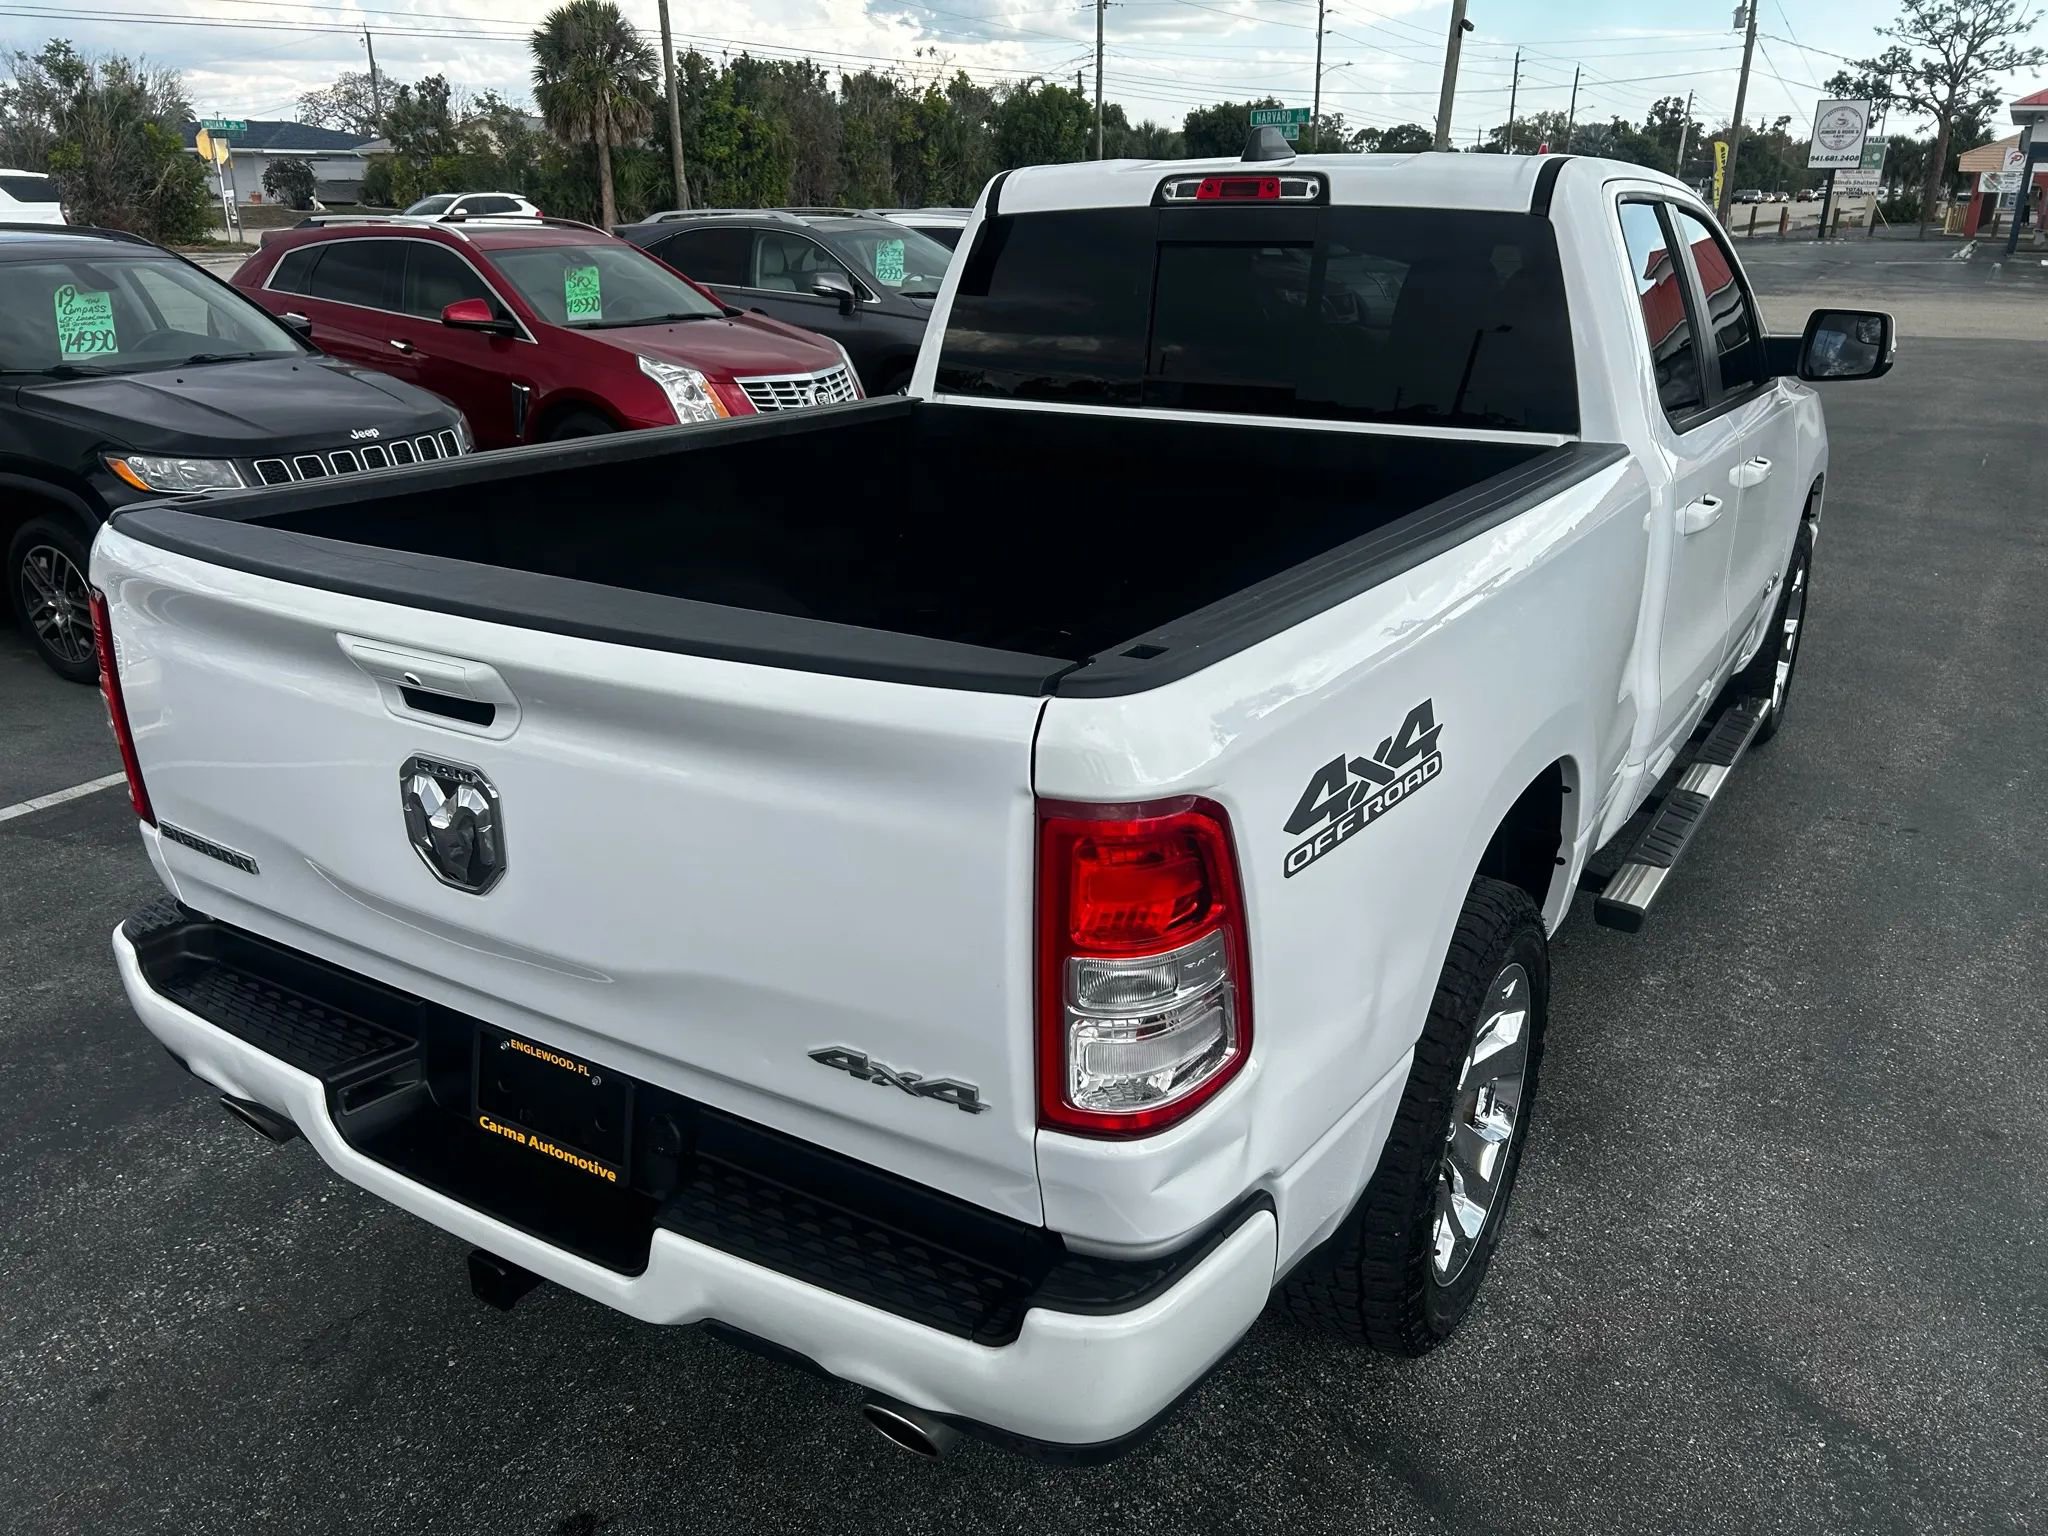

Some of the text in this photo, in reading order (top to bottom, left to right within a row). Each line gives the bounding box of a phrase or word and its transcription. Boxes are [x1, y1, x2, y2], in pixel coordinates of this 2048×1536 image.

[1256, 110, 1292, 123] HARVARD
[58, 286, 75, 307] 19
[350, 428, 380, 440] Jeep
[416, 759, 476, 784] RAM
[1287, 756, 1440, 873] OFF ROAD
[510, 1039, 590, 1077] ENGLEWOOD, FL
[479, 1115, 617, 1182] Carma Automotive
